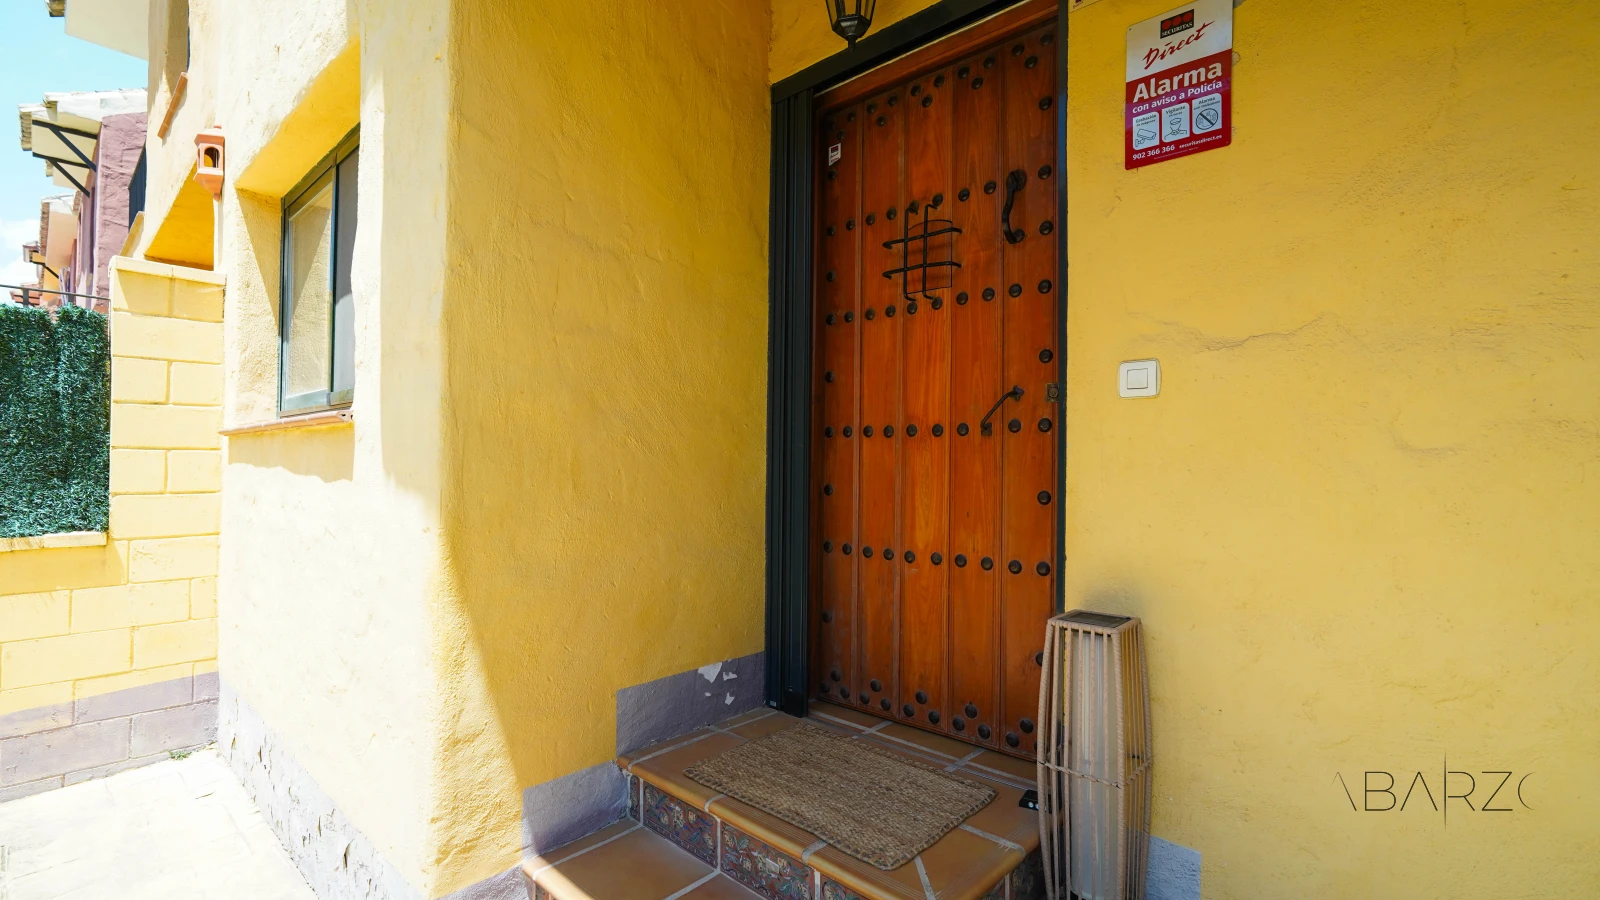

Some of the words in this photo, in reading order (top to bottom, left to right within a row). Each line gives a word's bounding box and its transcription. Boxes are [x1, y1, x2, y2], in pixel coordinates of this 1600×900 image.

[1142, 20, 1215, 70] Direct
[1162, 22, 1193, 37] SECURITAS
[1132, 104, 1149, 114] con
[1151, 94, 1177, 108] aviso
[1187, 80, 1223, 97] Policía
[1133, 62, 1222, 103] Alarma
[1132, 152, 1146, 161] 902
[1147, 148, 1160, 157] 366
[1161, 144, 1175, 154] 366
[1179, 134, 1222, 149] securitasdirect.es
